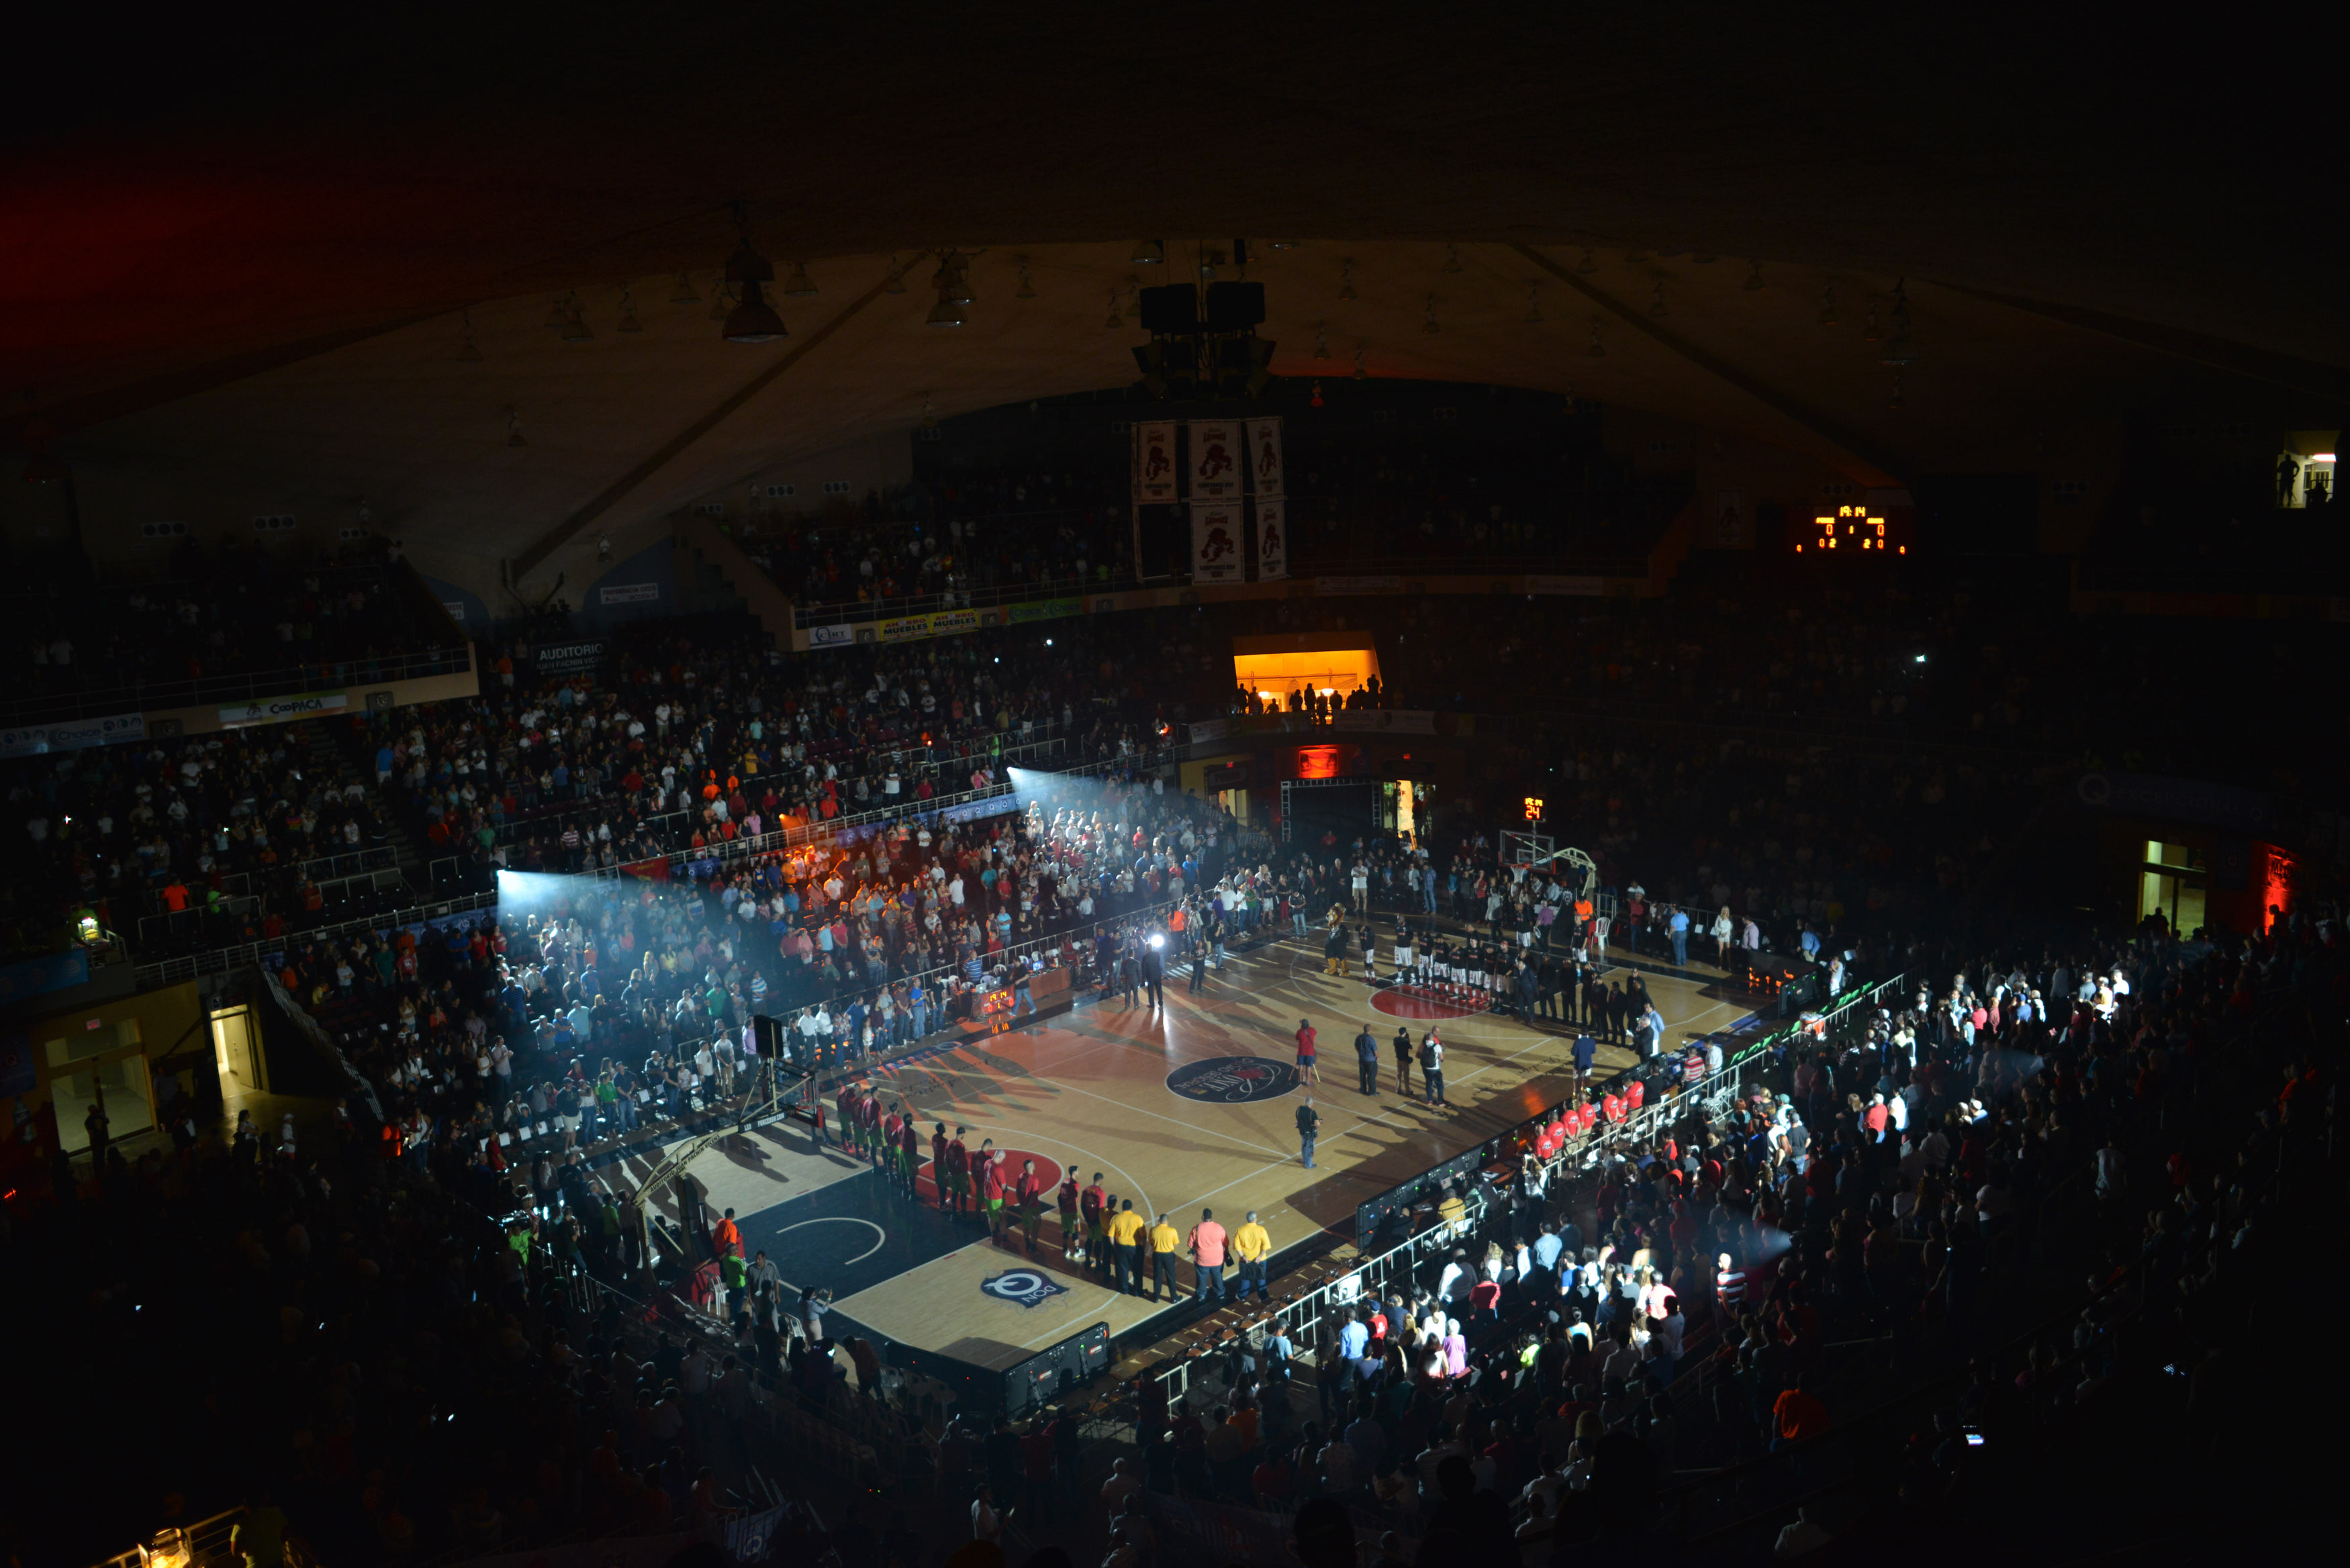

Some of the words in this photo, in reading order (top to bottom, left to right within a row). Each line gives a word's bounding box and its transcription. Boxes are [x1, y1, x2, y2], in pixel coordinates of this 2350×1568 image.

[1826, 524, 1833, 536] 0
[1877, 524, 1884, 536] 0
[884, 623, 928, 635] MUEBLES
[933, 617, 976, 628] MUEBLES
[540, 643, 603, 660] AUDITORIO
[1525, 805, 1540, 819] 24
[650, 1169, 675, 1192] AUDITORIO
[675, 1162, 688, 1172] JUAN
[688, 1147, 704, 1162] PACHIN
[704, 1134, 720, 1148] VICENS
[983, 1273, 1042, 1296] Q
[1022, 1285, 1057, 1302] DON
